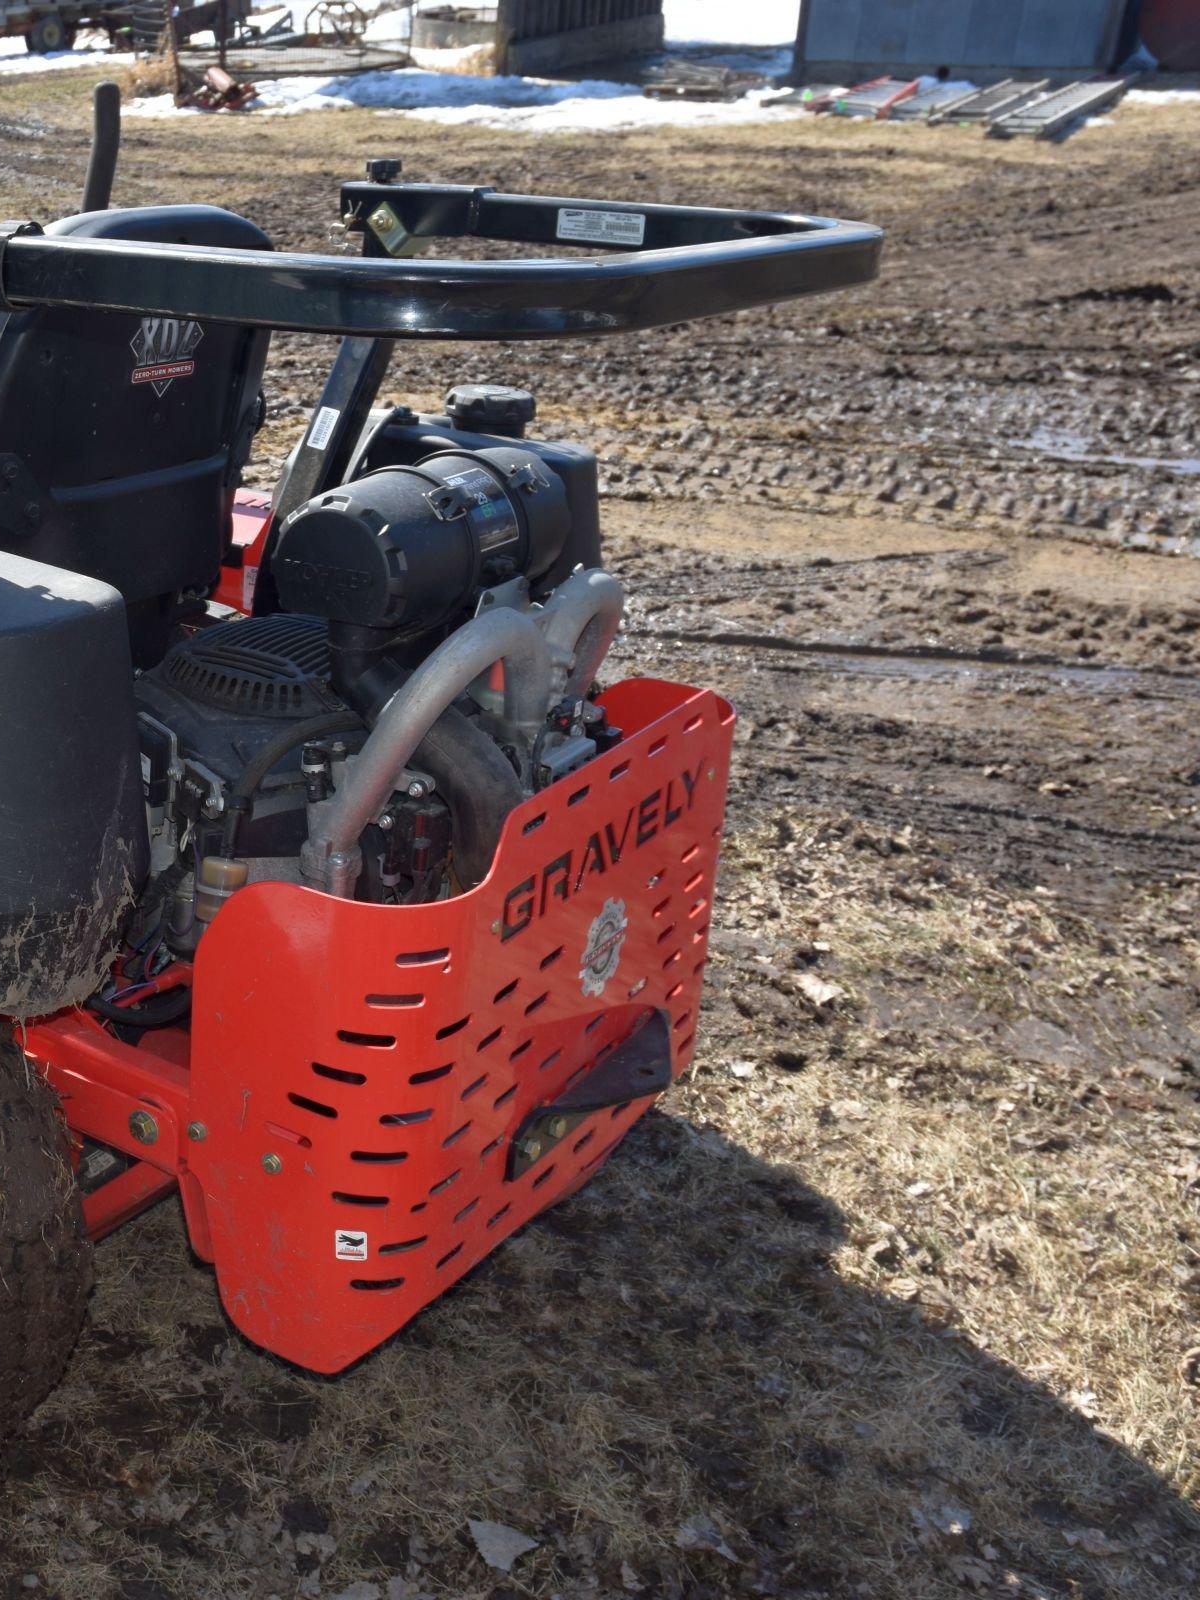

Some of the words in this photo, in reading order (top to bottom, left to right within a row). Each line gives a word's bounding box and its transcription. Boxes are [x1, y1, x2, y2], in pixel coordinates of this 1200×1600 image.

[134, 368, 167, 379] ZERO-TURN
[167, 364, 192, 374] MOWERS
[501, 757, 708, 943] GRAVELY
